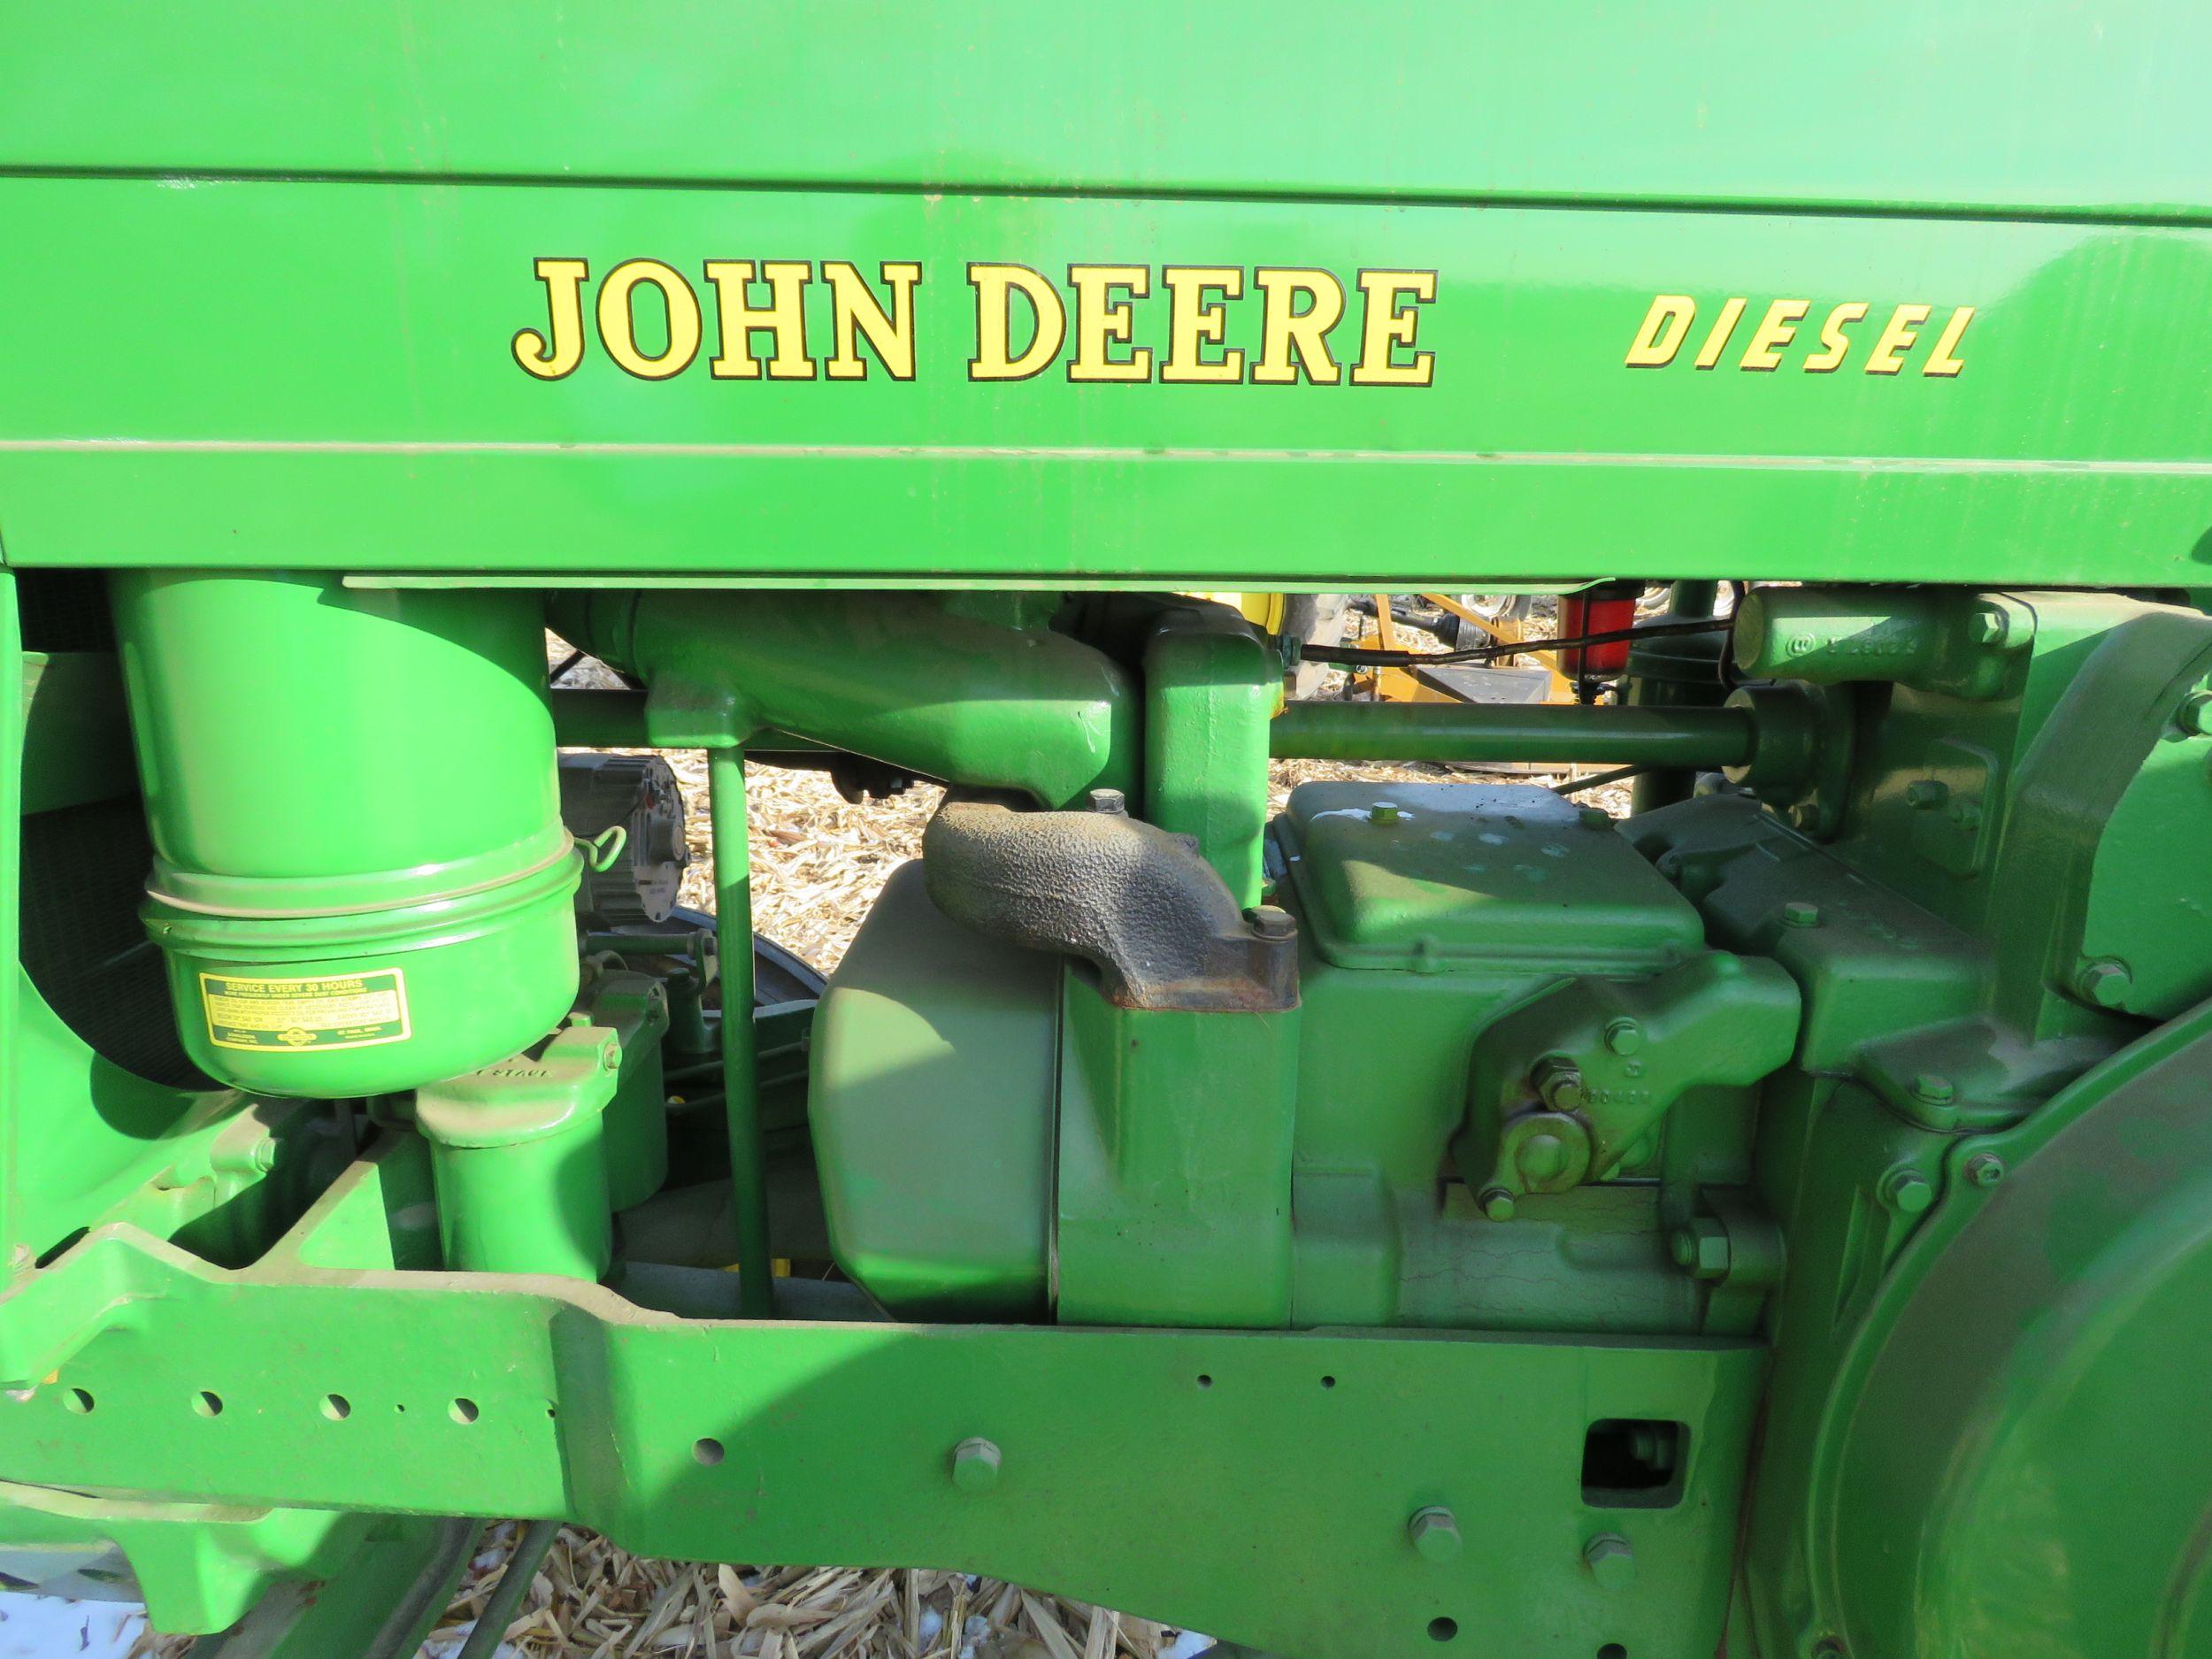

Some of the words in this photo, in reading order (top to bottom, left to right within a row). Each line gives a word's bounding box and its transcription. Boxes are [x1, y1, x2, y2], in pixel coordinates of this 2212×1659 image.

[511, 257, 922, 381] JOHN
[966, 262, 1439, 388] DEERE
[1624, 295, 1977, 378] DIESEL
[225, 982, 265, 993] SERVICE
[268, 983, 302, 993] EVERY
[305, 983, 319, 992] 30
[322, 979, 363, 990] HOURS
